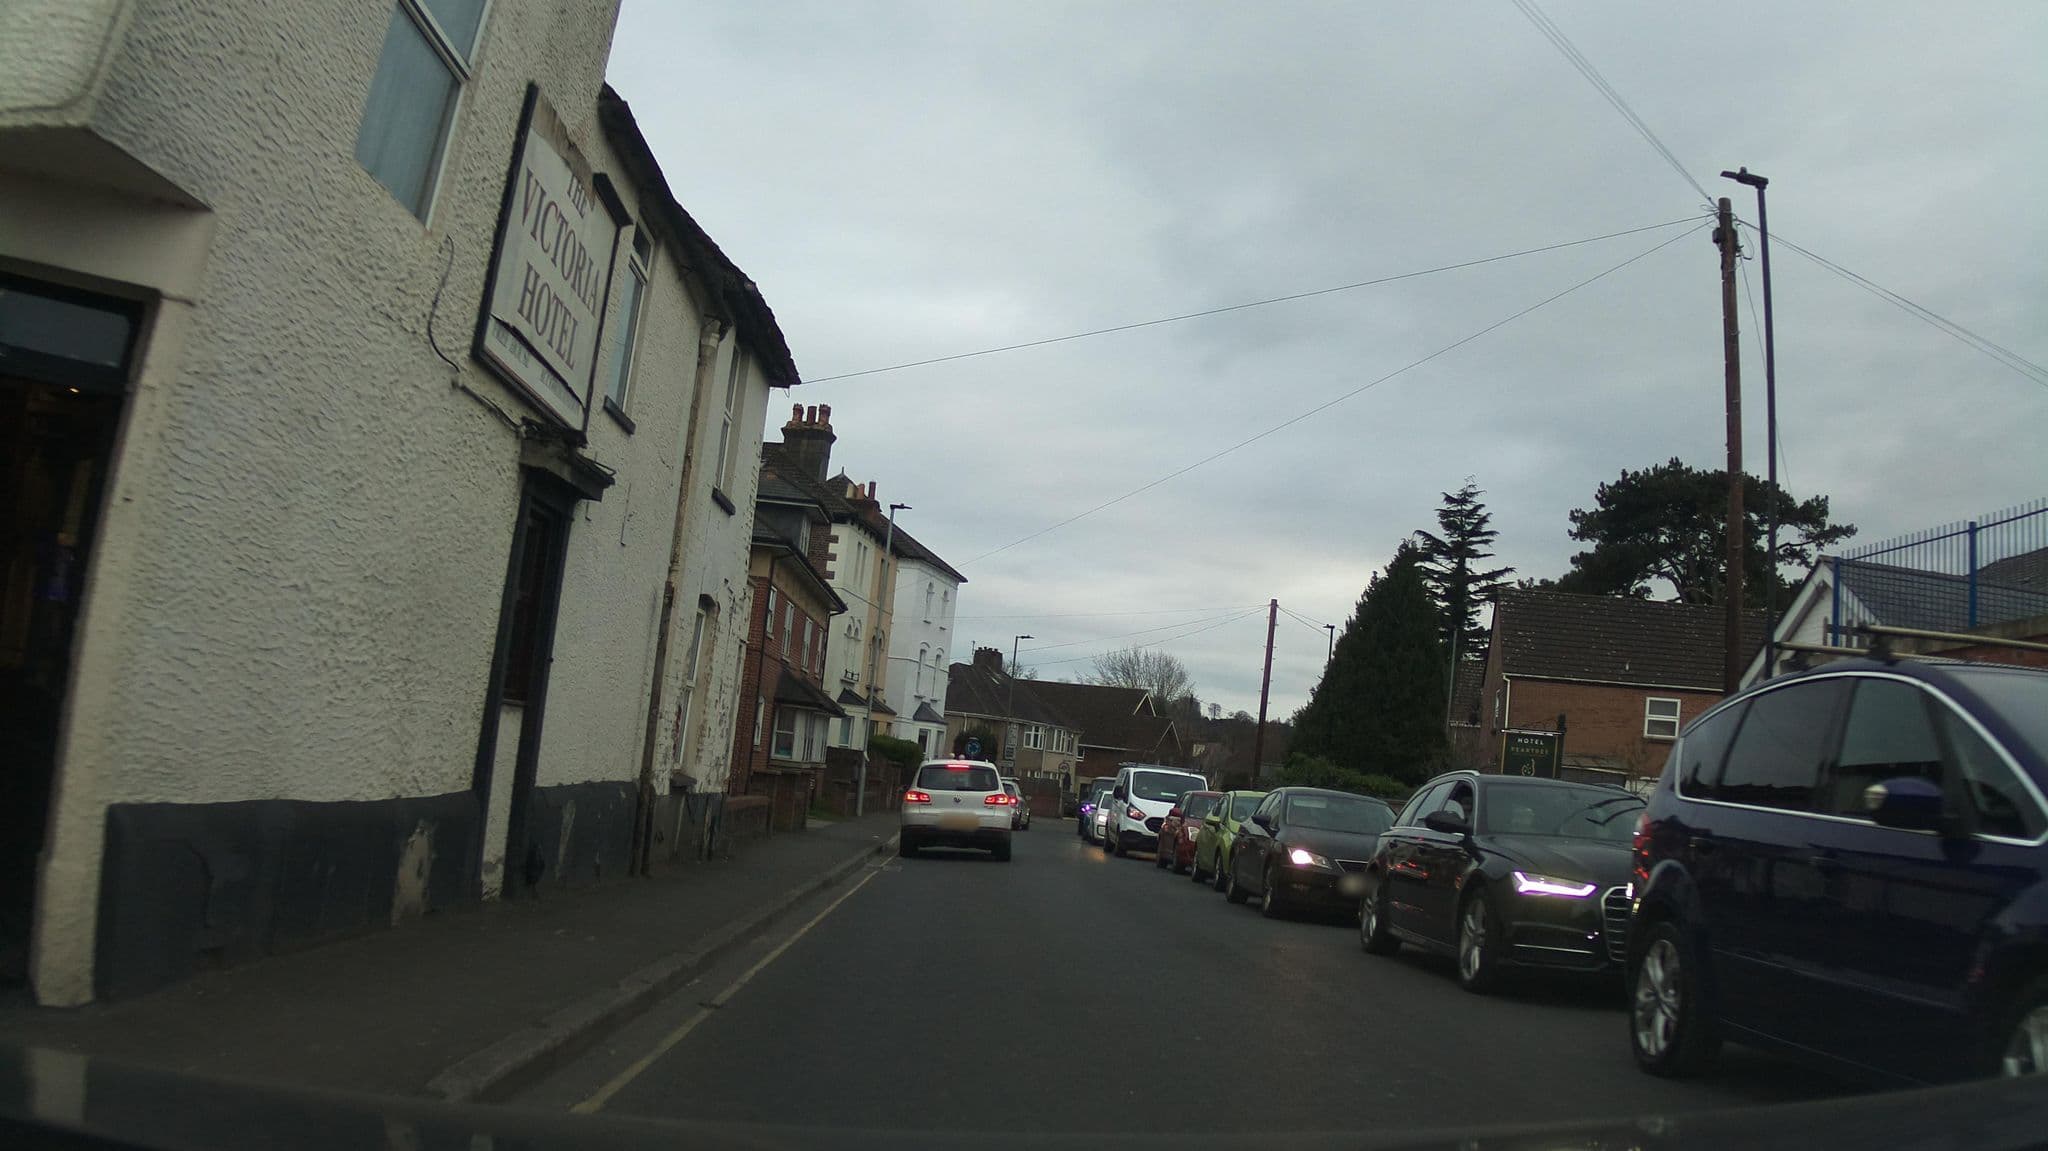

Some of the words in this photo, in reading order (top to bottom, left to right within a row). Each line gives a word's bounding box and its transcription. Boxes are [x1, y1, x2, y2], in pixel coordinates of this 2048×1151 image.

[521, 168, 600, 318] VICTORIA
[567, 173, 587, 219] THE
[517, 260, 578, 370] HOTEL
